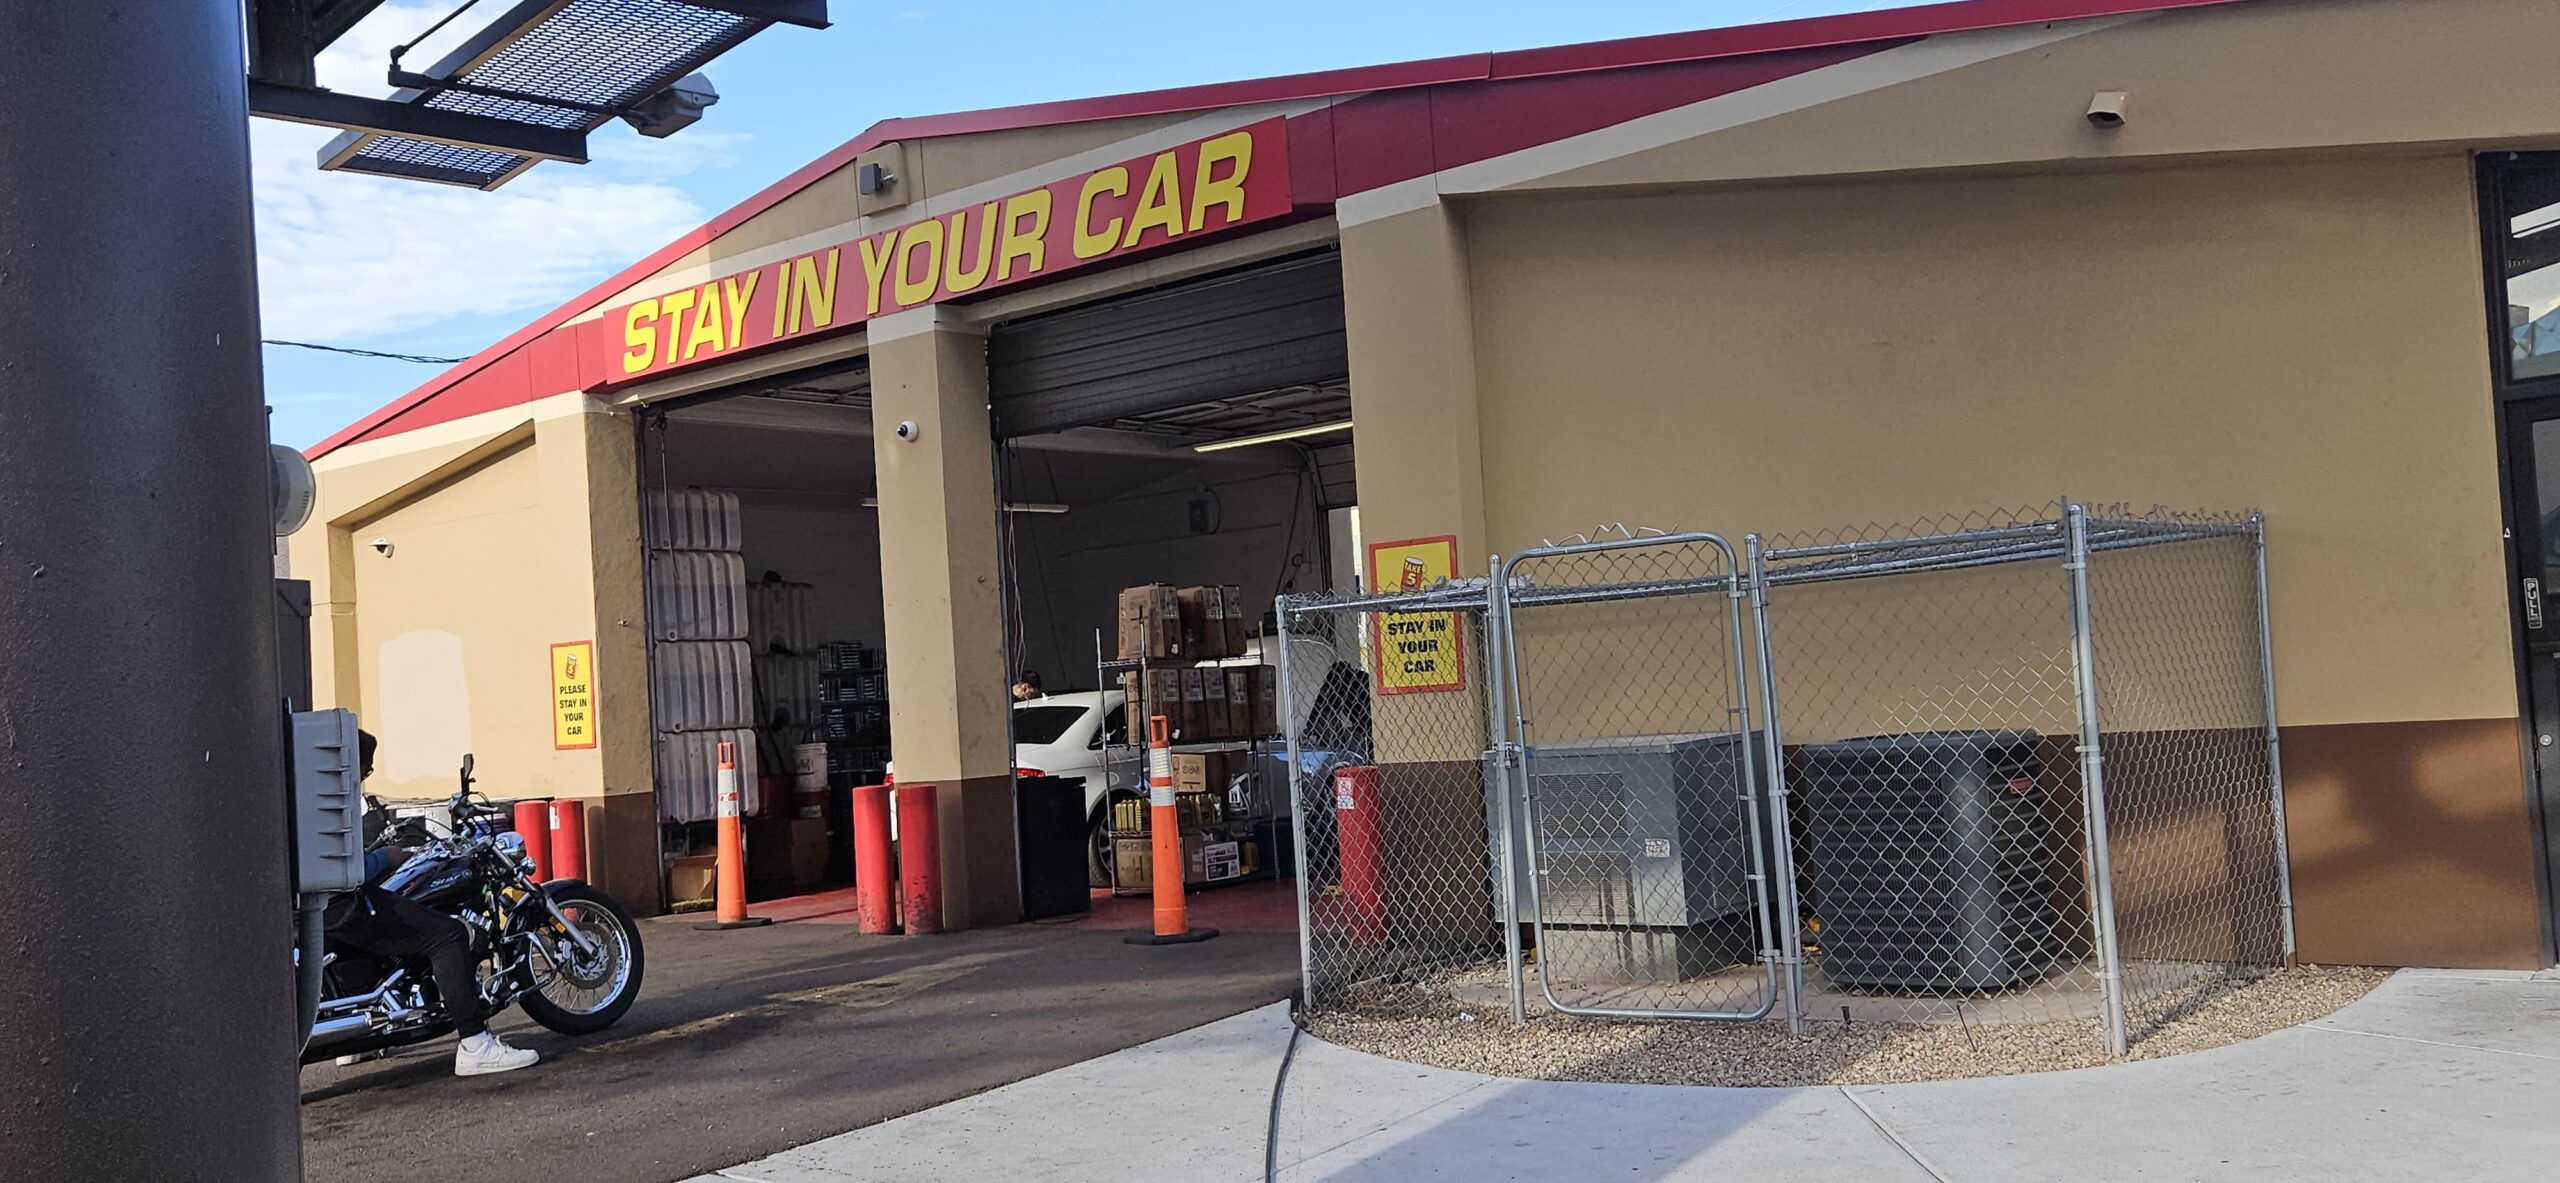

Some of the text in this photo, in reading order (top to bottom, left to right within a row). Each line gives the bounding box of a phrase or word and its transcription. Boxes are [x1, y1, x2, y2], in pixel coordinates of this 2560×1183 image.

[624, 131, 1253, 374] STAY IN YOUR CAR
[1404, 561, 1422, 574] TAKE
[1407, 573, 1417, 586] 5
[2527, 582, 2538, 616] PULL
[1388, 618, 1446, 635] STAY IN
[1398, 639, 1438, 653] YOUR
[1404, 660, 1435, 673] CAR
[560, 685, 586, 695] PLEASE
[560, 698, 587, 709] STAY IN
[564, 713, 583, 722] YOUR
[567, 727, 582, 735] CAR
